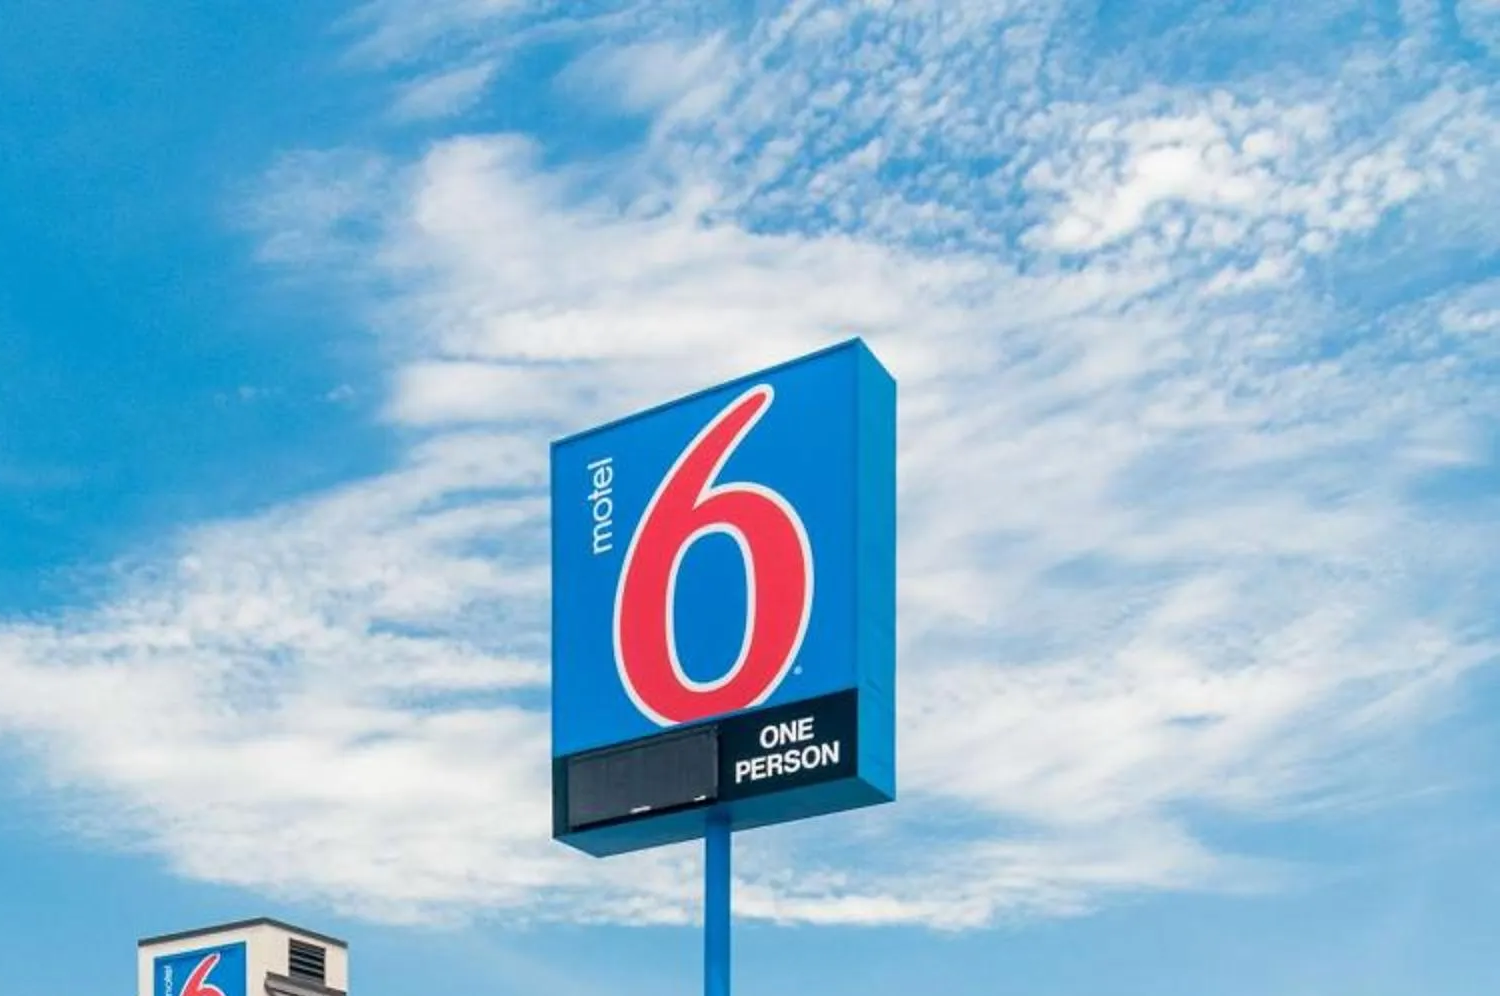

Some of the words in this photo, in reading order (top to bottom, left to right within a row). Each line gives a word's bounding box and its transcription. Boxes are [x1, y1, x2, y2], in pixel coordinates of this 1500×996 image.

[587, 457, 612, 554] motel
[613, 383, 814, 726] 6
[735, 740, 840, 784] PERSON
[759, 716, 815, 748] ONE
